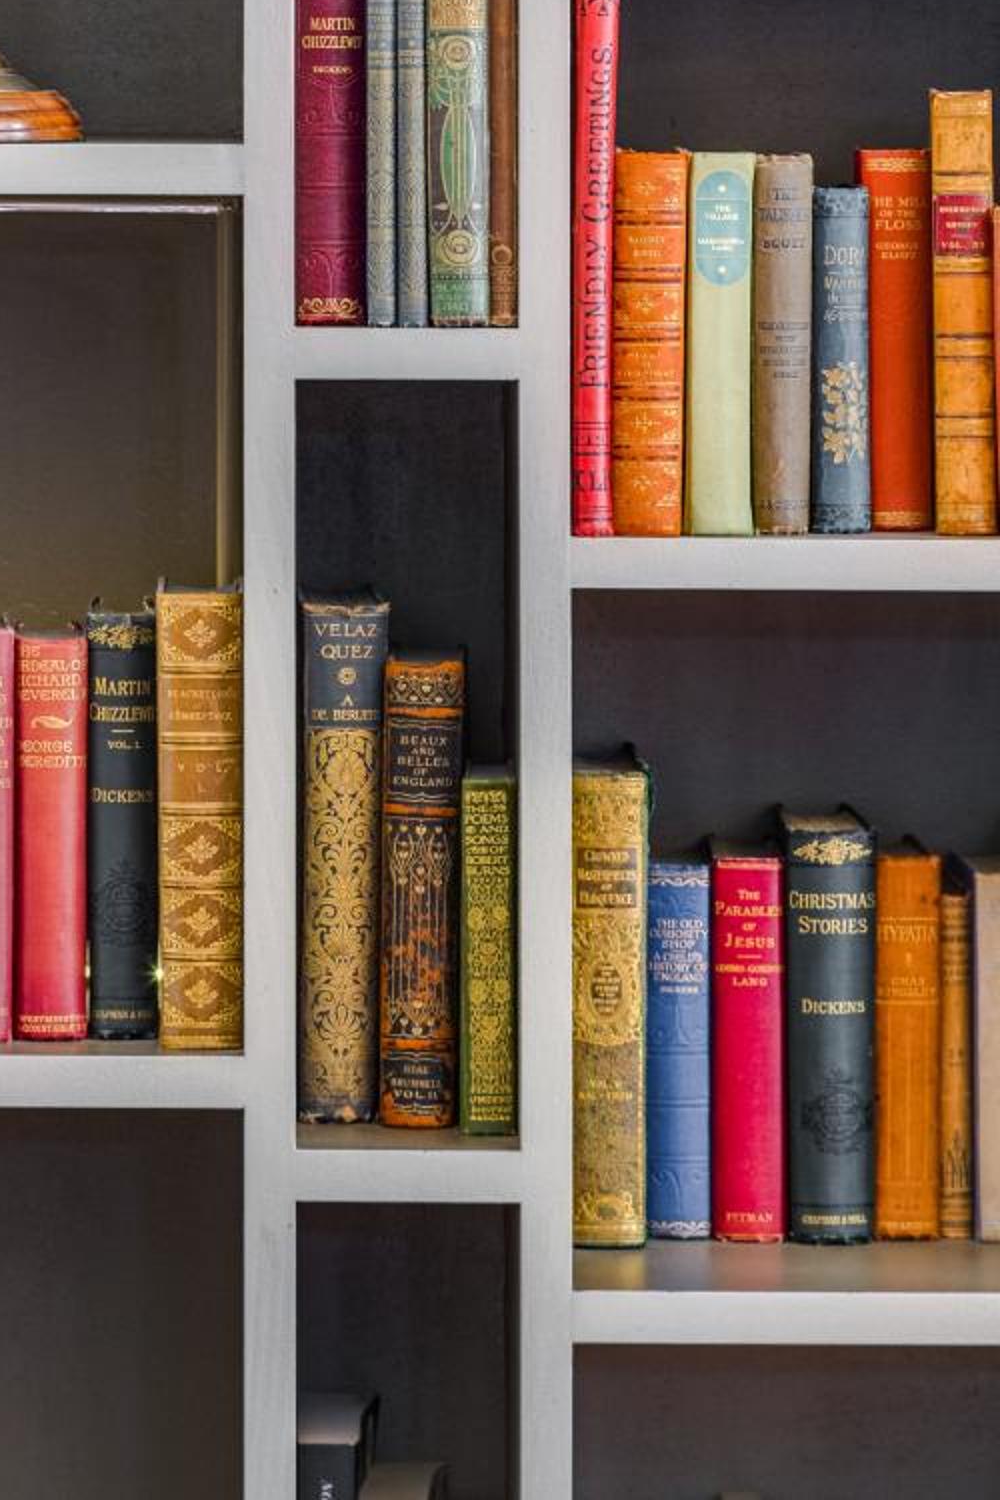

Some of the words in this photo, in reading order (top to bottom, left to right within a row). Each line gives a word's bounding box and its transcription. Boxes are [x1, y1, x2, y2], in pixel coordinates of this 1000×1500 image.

[310, 17, 355, 31] MARTIN
[581, 232, 609, 388] FRIENDLY
[315, 624, 377, 638] VELAZ
[321, 645, 374, 660] QUEZ
[94, 677, 150, 696] MARTIN
[107, 740, 133, 749] VOL.
[399, 736, 448, 746] BEAUX
[397, 756, 450, 767] BELLES
[413, 768, 428, 776] OF
[393, 777, 452, 787] ENGLAND
[93, 789, 152, 803] DICKENS
[465, 814, 508, 824] POEMS
[465, 835, 509, 846] SONGS
[466, 866, 510, 876] BURNS
[738, 890, 760, 900] THE
[790, 891, 875, 909] CHRISTMAS
[656, 919, 677, 928] THE
[680, 919, 703, 928] OLD
[743, 922, 756, 930] OF
[799, 916, 868, 934] STORIES
[662, 940, 694, 949] SHOP
[724, 934, 775, 948] JESUS
[732, 977, 768, 987] LANG
[801, 999, 865, 1014] DICKENS
[726, 1212, 773, 1222] PITMAN
